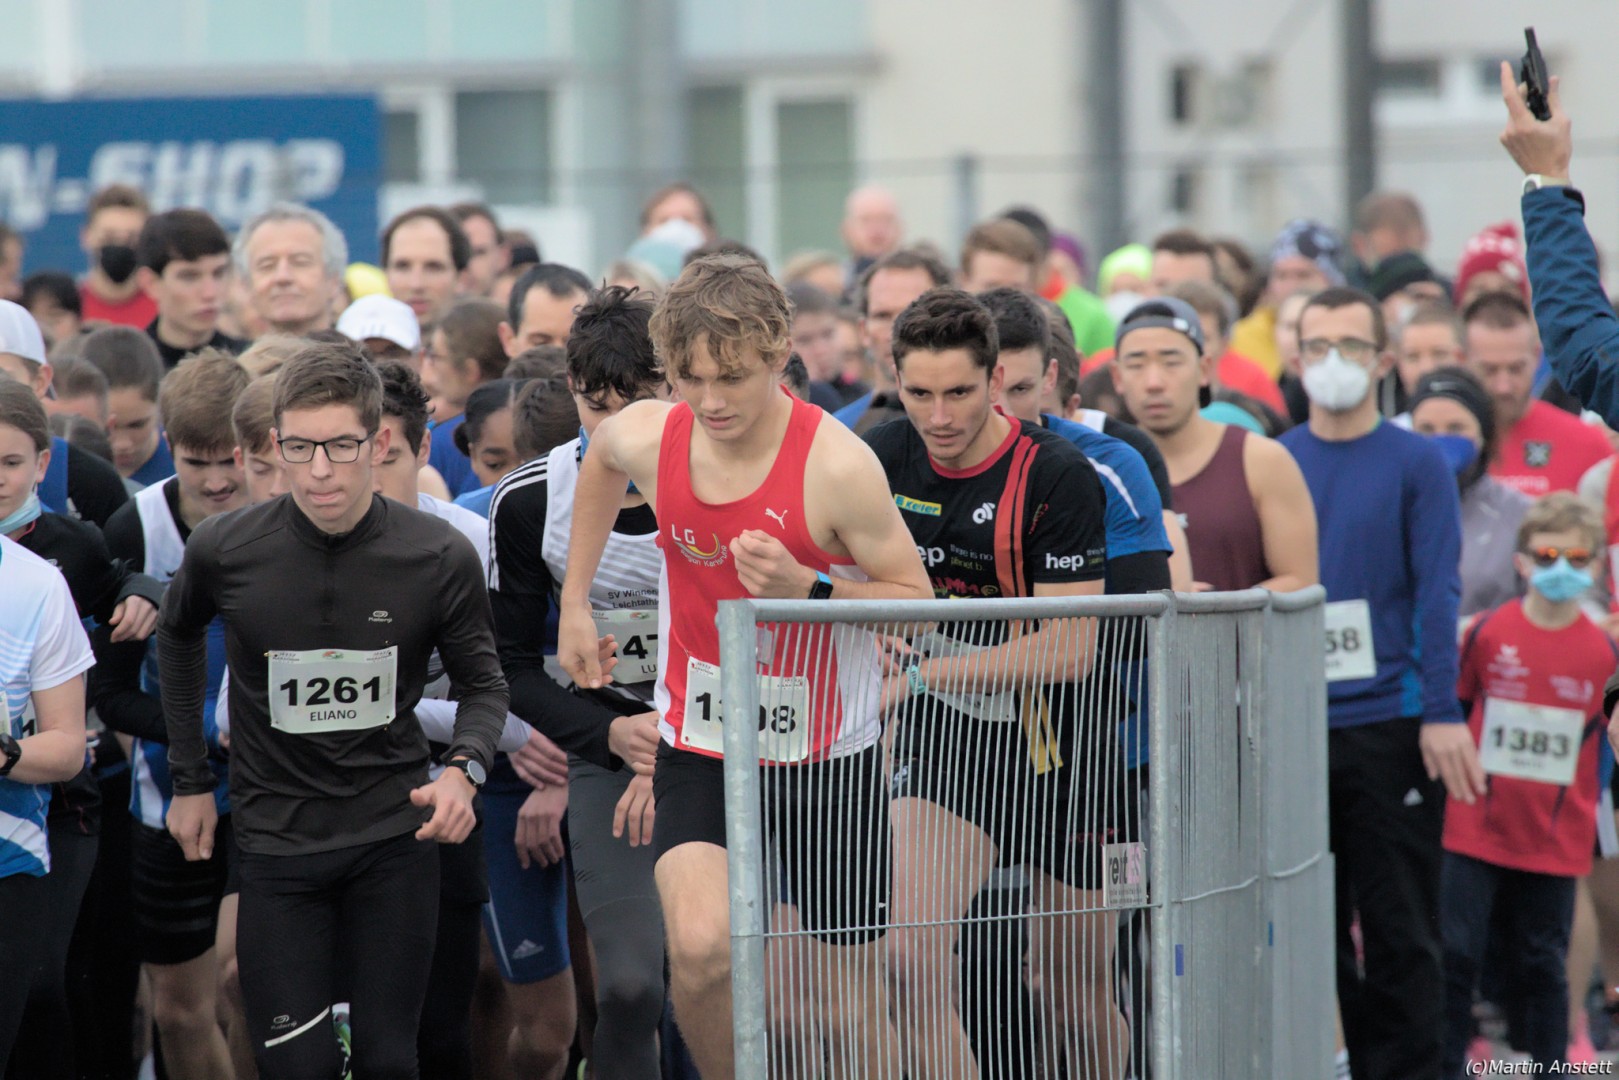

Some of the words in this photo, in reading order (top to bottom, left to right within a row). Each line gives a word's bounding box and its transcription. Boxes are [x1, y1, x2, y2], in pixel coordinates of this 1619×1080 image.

[671, 523, 696, 545] LG
[1045, 552, 1085, 572] hep
[607, 591, 620, 600] SV
[280, 675, 380, 707] 1261
[309, 709, 357, 722] ELIANO
[1491, 723, 1570, 760] 1383
